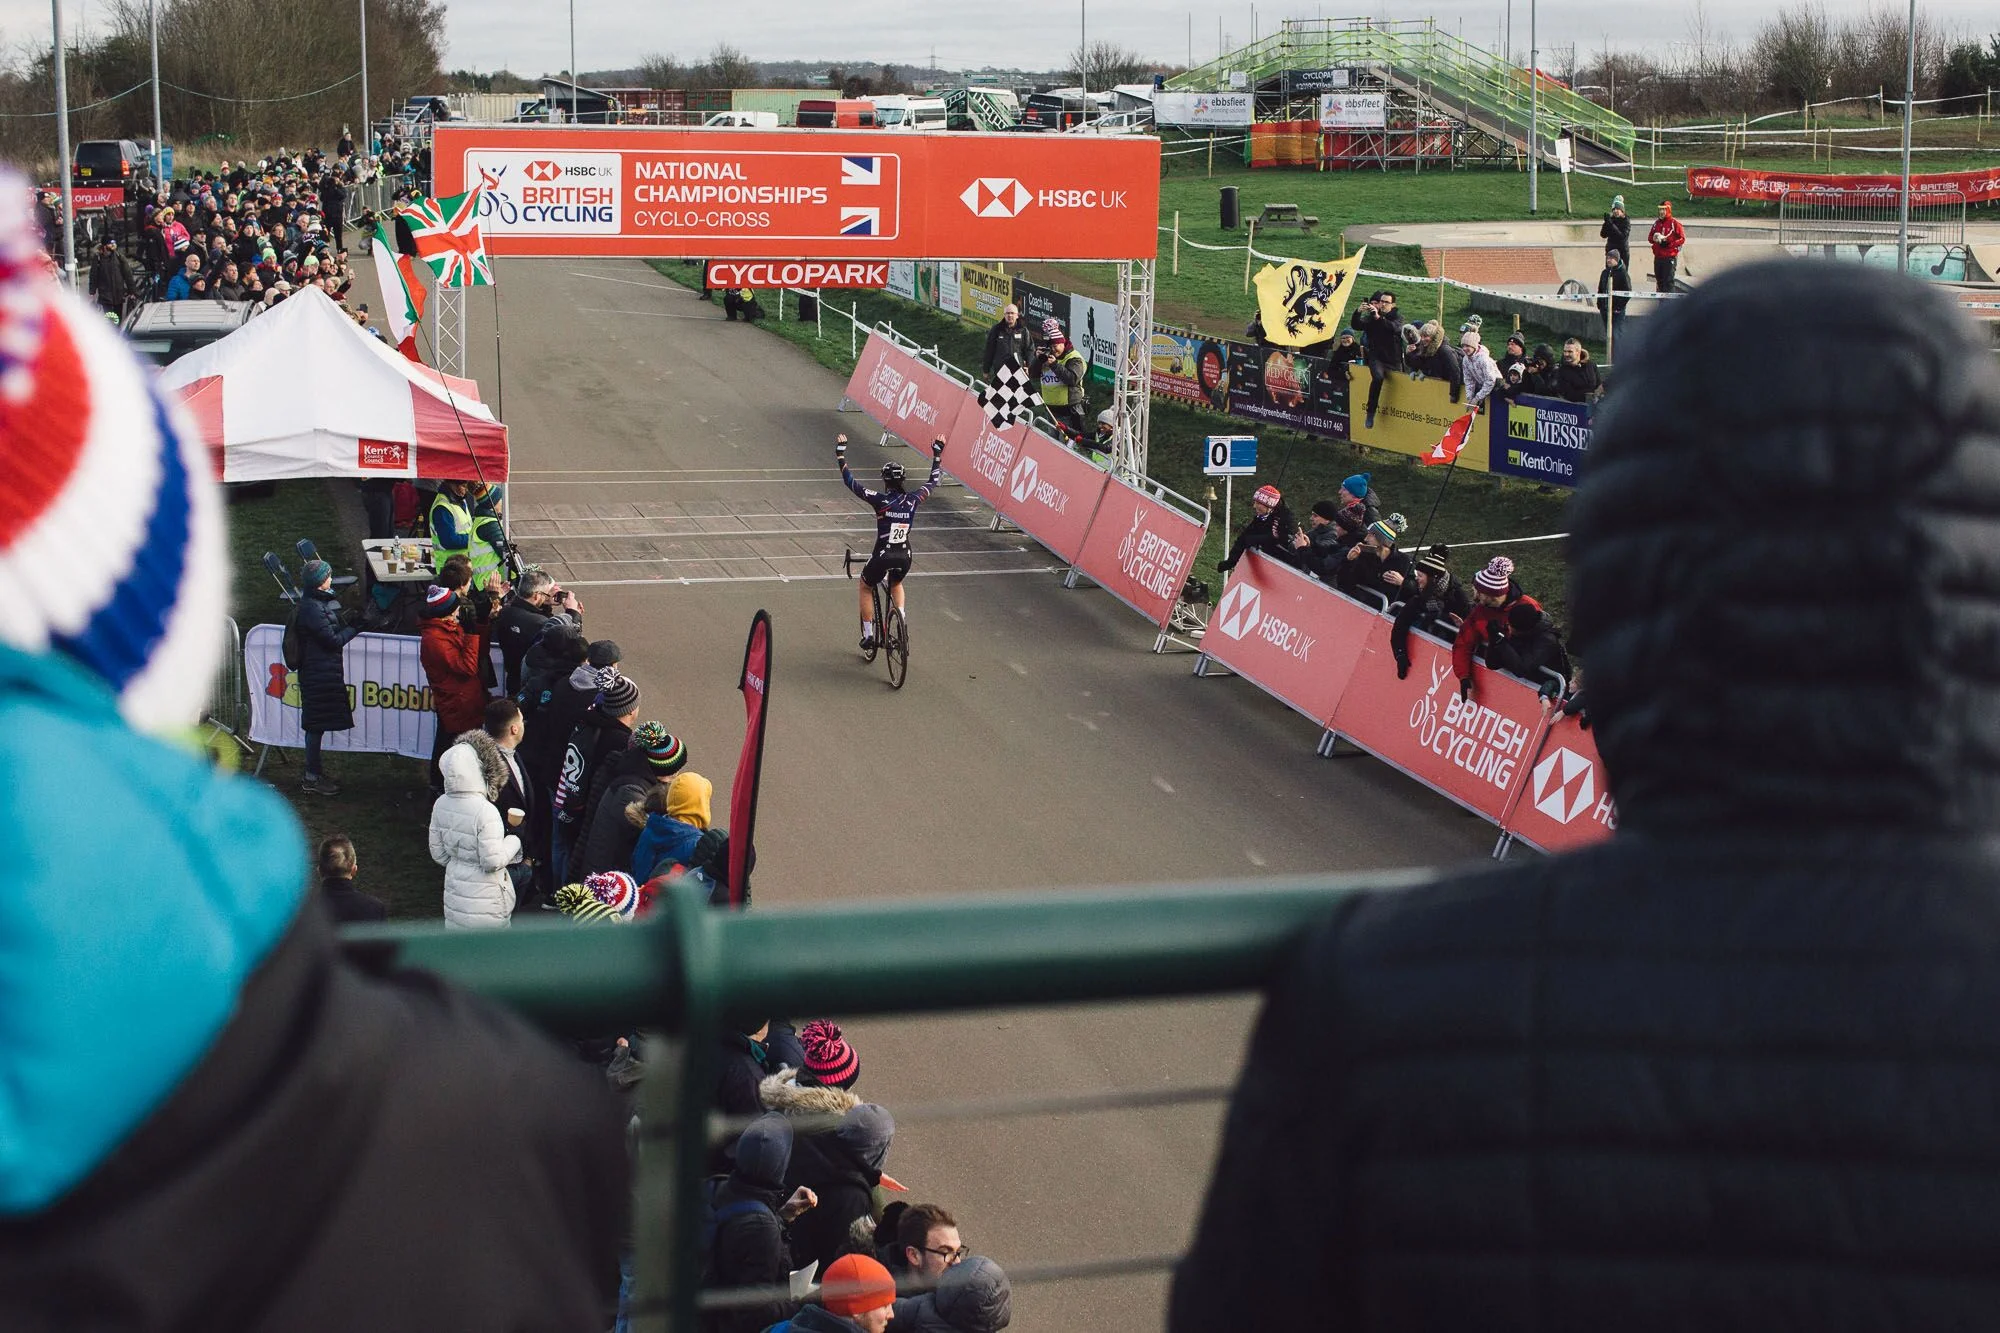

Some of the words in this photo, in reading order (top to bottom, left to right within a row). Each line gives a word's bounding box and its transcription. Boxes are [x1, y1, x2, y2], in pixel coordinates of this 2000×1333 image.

[1211, 97, 1246, 106] ebbsfleet
[1345, 98, 1380, 108] ebbsfleet
[565, 166, 597, 176] HSBC
[598, 167, 613, 176] UK
[634, 161, 748, 181] NATIONAL
[1702, 175, 1731, 189] ride
[1920, 182, 1959, 191] BRITISH
[1978, 177, 2000, 193] rac
[522, 186, 613, 205] BRITISH
[634, 184, 828, 205] CHAMPIONSHIPS
[1038, 189, 1097, 208] HSBC
[1100, 190, 1128, 209] UK
[522, 205, 613, 223] CYCLING
[633, 210, 771, 228] CYCLO-CROSS
[709, 263, 887, 286] CYCLOPARK
[963, 267, 989, 290] WATLING
[990, 275, 1010, 297] TYRES
[1028, 292, 1043, 309] Coach
[1043, 297, 1053, 313] Hire
[880, 363, 904, 393] BRITISH
[1266, 366, 1280, 378] RED
[873, 381, 896, 410] CYCLING
[913, 398, 931, 422] HSBC
[927, 408, 940, 427] UK
[1390, 407, 1442, 427] Mercedes-Benz
[1536, 408, 1578, 425] GRAVESEND
[1307, 416, 1323, 428] 01322
[1323, 419, 1332, 430] 617
[1333, 421, 1344, 432] 460
[1509, 420, 1529, 438] KM
[364, 445, 388, 455] Kent
[984, 431, 1015, 467] BRITISH
[1211, 442, 1228, 467] 0
[977, 453, 1008, 488] CYCLING
[1520, 451, 1573, 476] KentOnline
[1034, 479, 1059, 508] HSBC
[1054, 492, 1070, 516] UK
[892, 528, 905, 540] 20
[1137, 529, 1186, 576] BRITISH
[1129, 554, 1176, 601] CYCLING
[1257, 612, 1298, 652] HSBC
[1292, 632, 1316, 663] UK
[1442, 691, 1530, 759] BRITISH
[1432, 725, 1516, 791] CYCLING
[1592, 791, 1620, 831] HS
